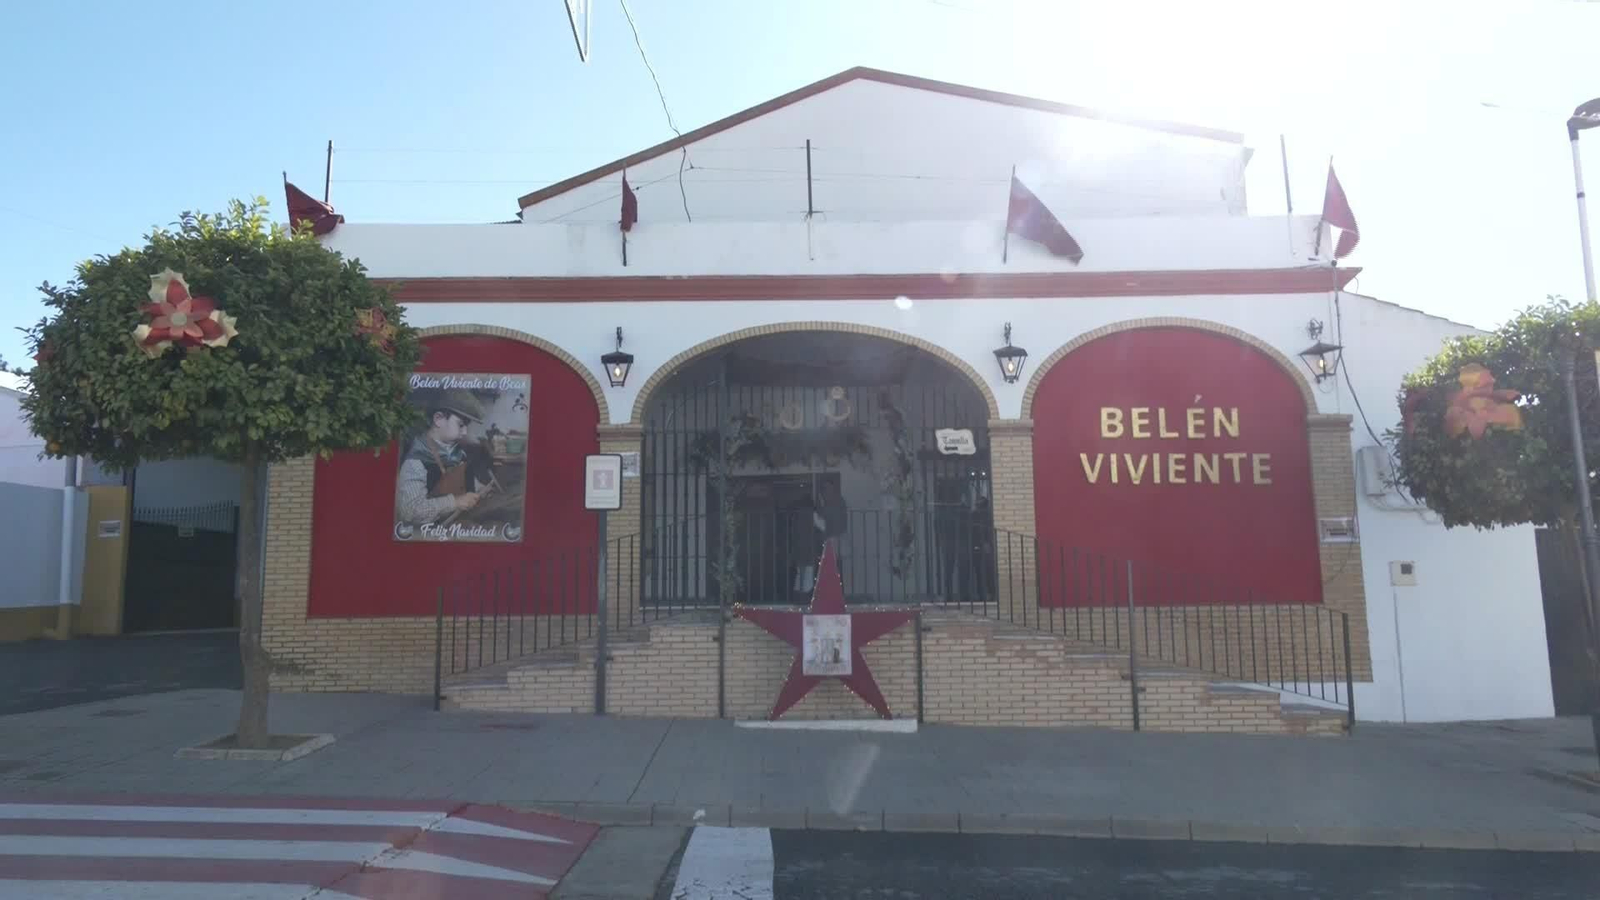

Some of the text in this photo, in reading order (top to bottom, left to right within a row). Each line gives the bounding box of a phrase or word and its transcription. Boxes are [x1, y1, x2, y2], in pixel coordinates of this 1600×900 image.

[409, 374, 440, 389] Belén
[442, 375, 482, 390] Viviente
[484, 378, 497, 389] de
[1100, 394, 1239, 438] BELÉN
[1079, 453, 1272, 485] VIVIENTE
[420, 523, 496, 541] Feliz Navidad
